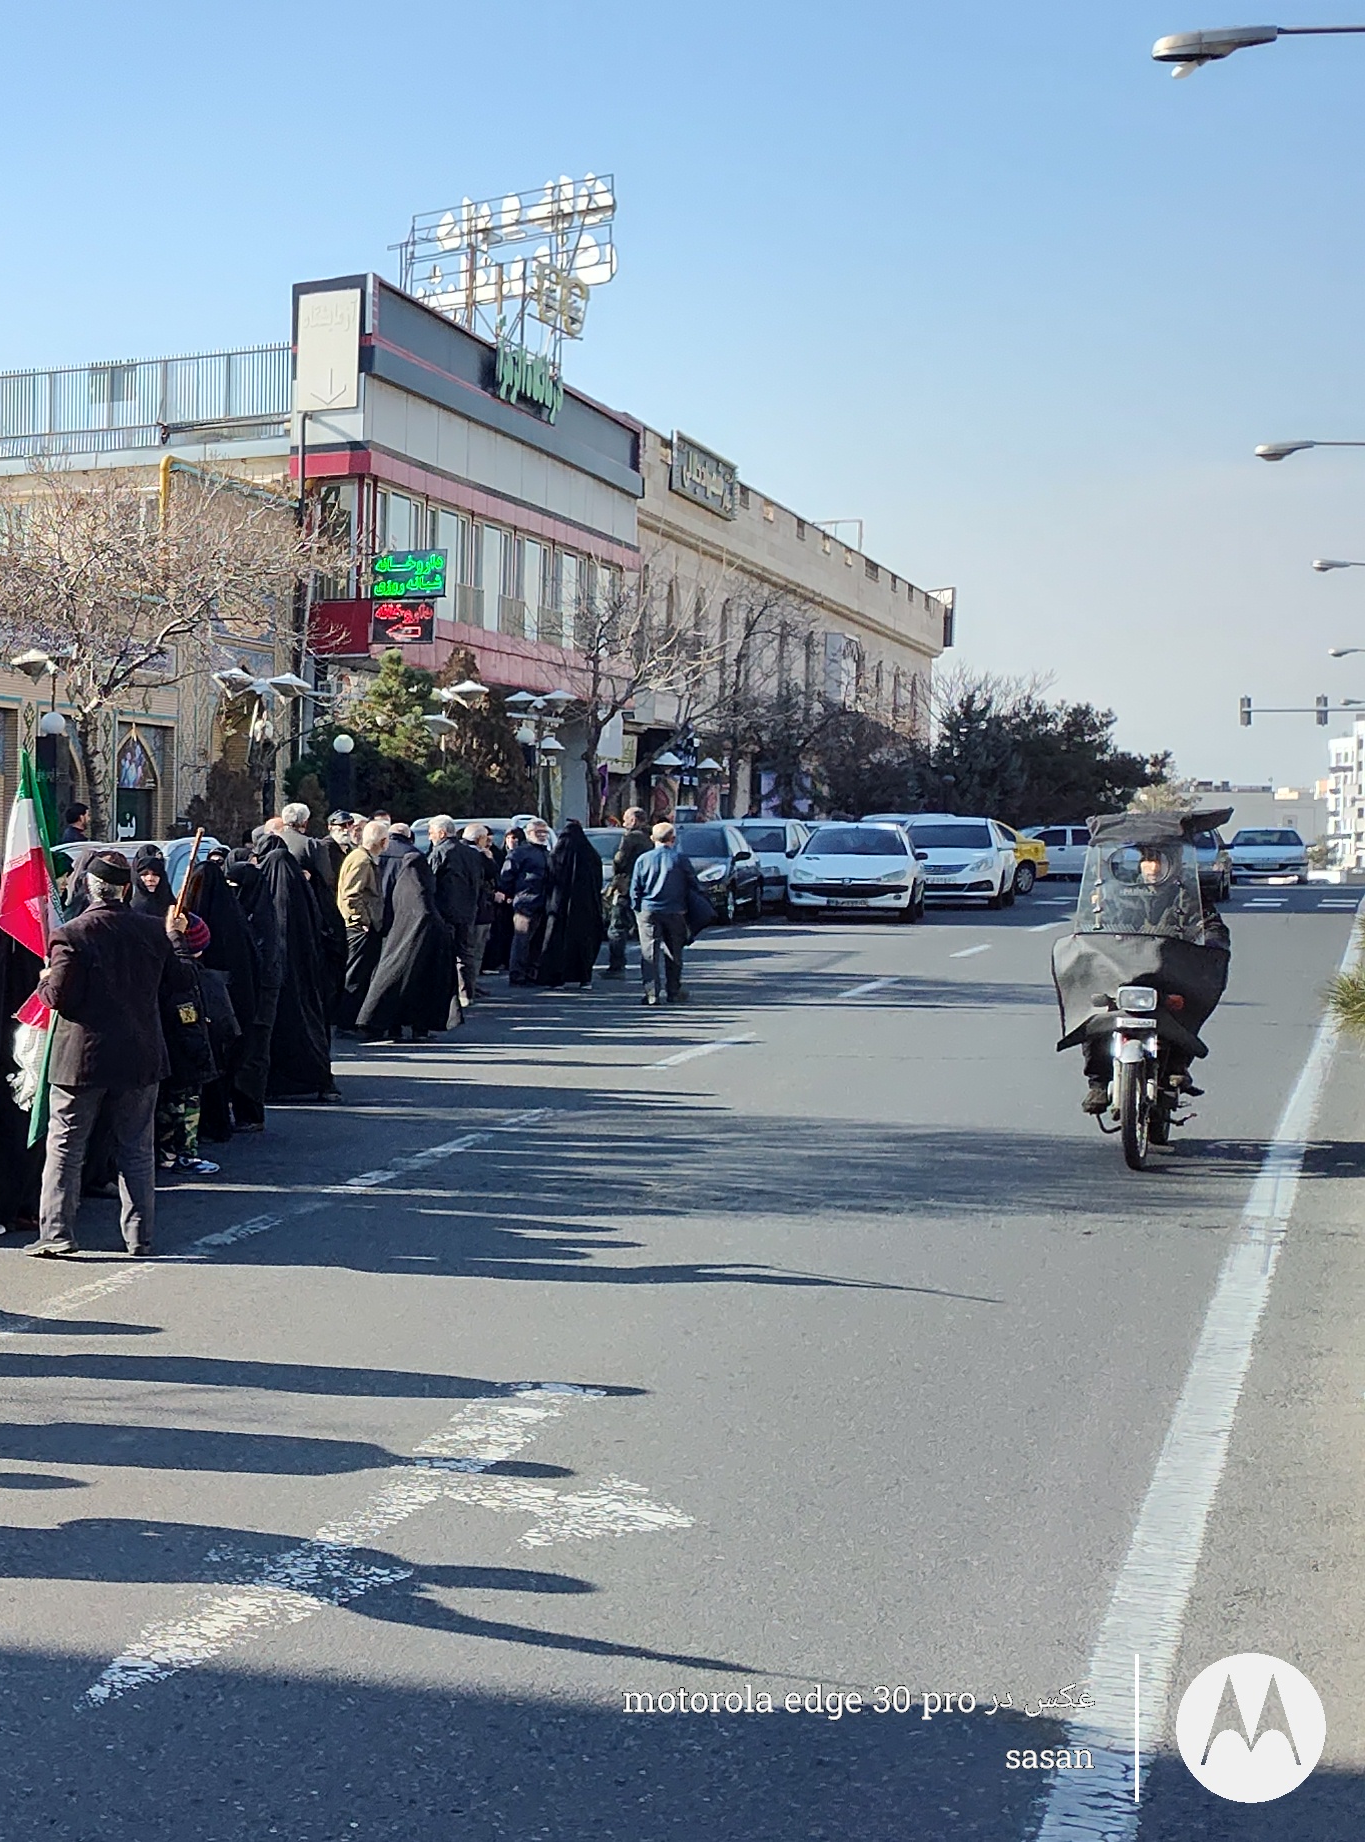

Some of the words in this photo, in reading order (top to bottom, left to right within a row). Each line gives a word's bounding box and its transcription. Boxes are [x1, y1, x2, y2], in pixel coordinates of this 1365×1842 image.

[374, 553, 445, 576] داروخانه
[373, 580, 406, 597] روزی
[406, 574, 443, 594] شبانه
[374, 603, 434, 624] داروخانه
